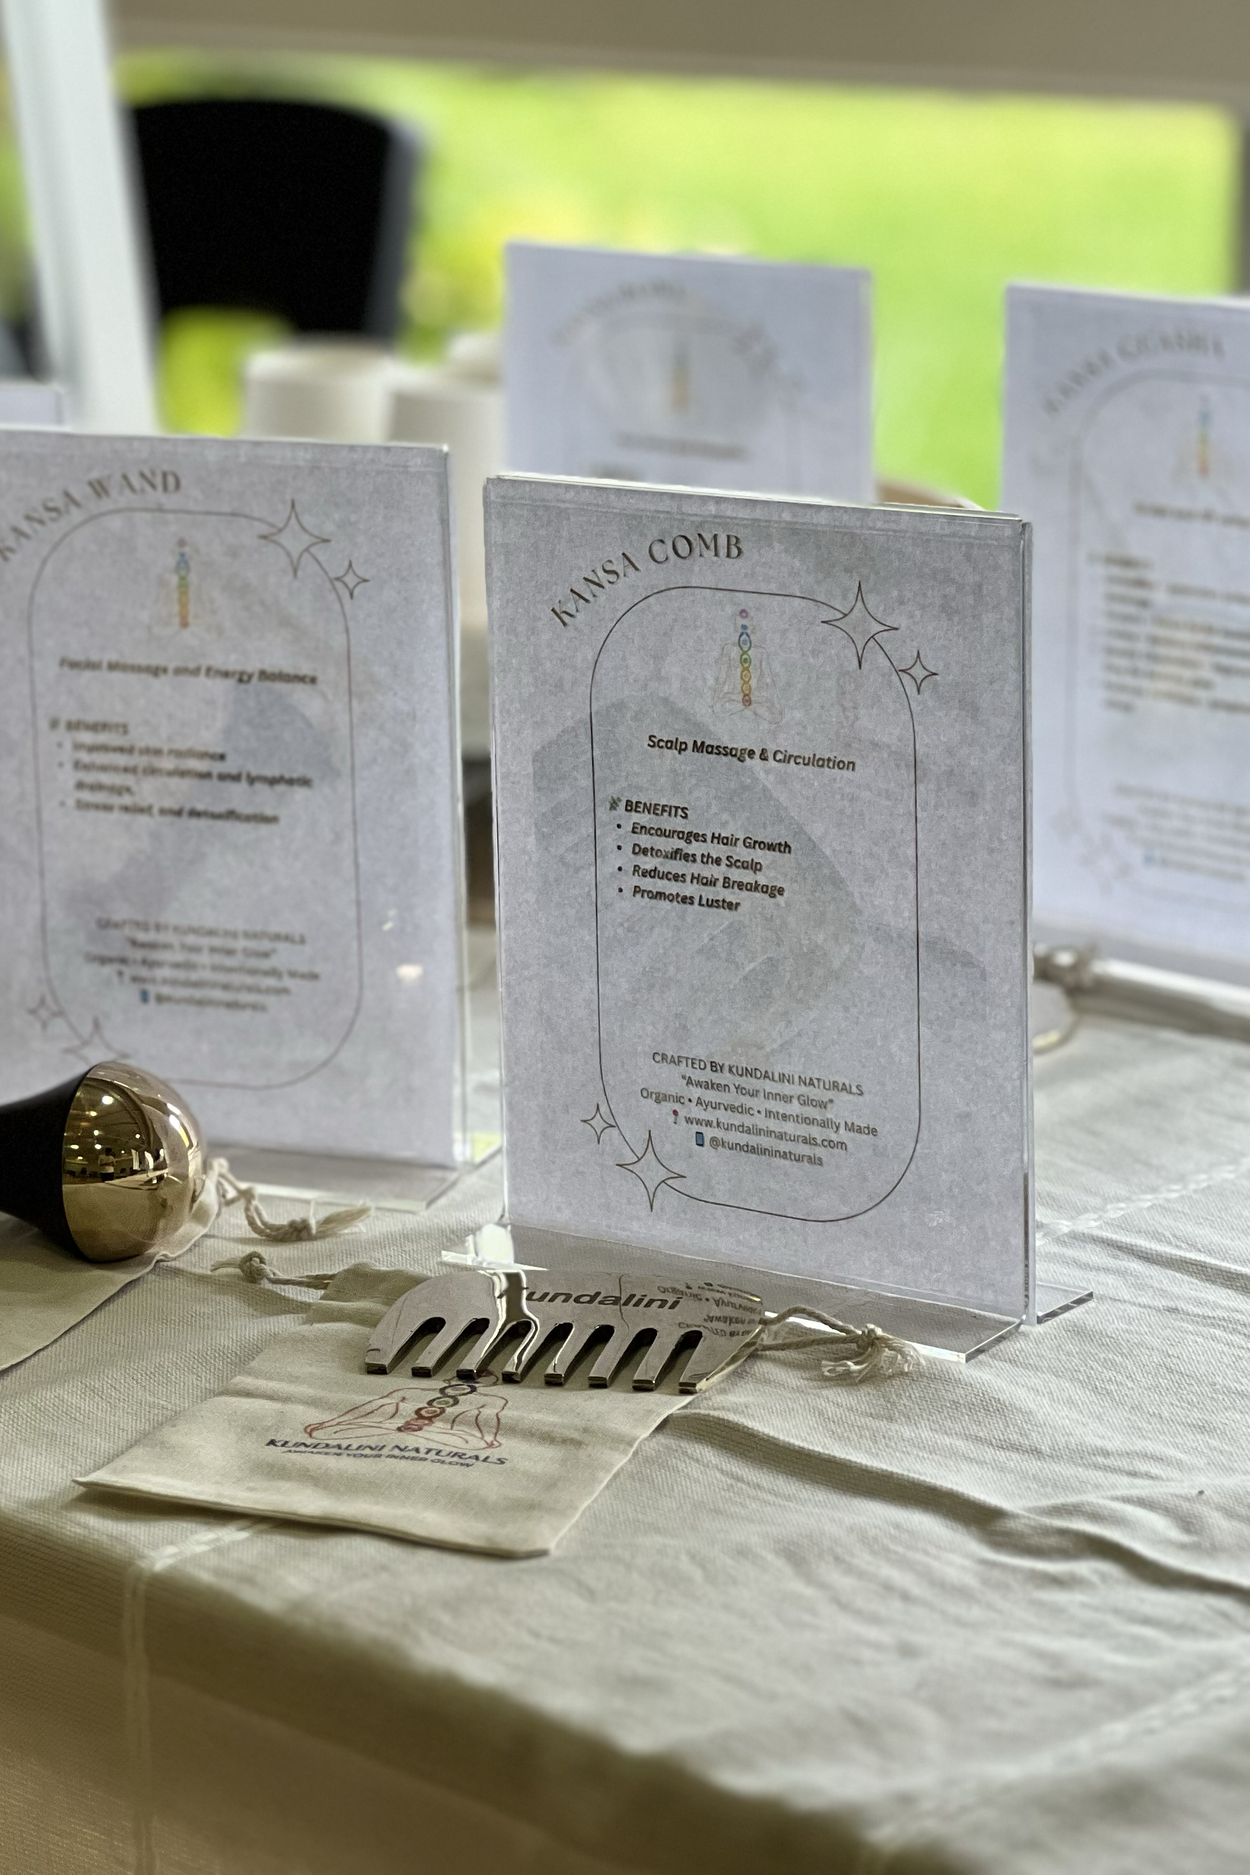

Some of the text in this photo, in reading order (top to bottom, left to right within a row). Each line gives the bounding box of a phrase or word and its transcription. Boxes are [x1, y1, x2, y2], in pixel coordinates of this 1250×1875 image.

[87, 470, 181, 500] WAND
[551, 533, 744, 627] KANSA COMB
[107, 660, 168, 678] Massage
[173, 663, 200, 677] and
[205, 665, 254, 683] Energy
[257, 669, 318, 685] Balance
[65, 720, 128, 735] BENEFITS
[647, 734, 856, 772] Scalp Massage & Circulation
[217, 769, 241, 783] and
[158, 805, 183, 818] and
[625, 799, 689, 819] BENEFITS
[631, 822, 792, 854] Encourages Hair Growth
[632, 844, 763, 874] Detoxifies the Scalp
[632, 865, 785, 897] Reduces Hair Breakage
[633, 886, 740, 912] Promotes Luster
[652, 1052, 864, 1096] CRAFTED BY KUNDALINI NATURALS
[734, 1083, 759, 1098] Your
[763, 1089, 794, 1104] Inner
[640, 1088, 878, 1136] Organic Ayurvedic Intentionally Made
[684, 1115, 848, 1151] www.kundalininaturals.com
[709, 1135, 823, 1166] @kundalininaturals
[497, 1286, 684, 1310] undalini
[265, 1439, 509, 1465] KUNDALINI NATURALS
[386, 1454, 427, 1462] INNER
[431, 1458, 475, 1468] GLOW
